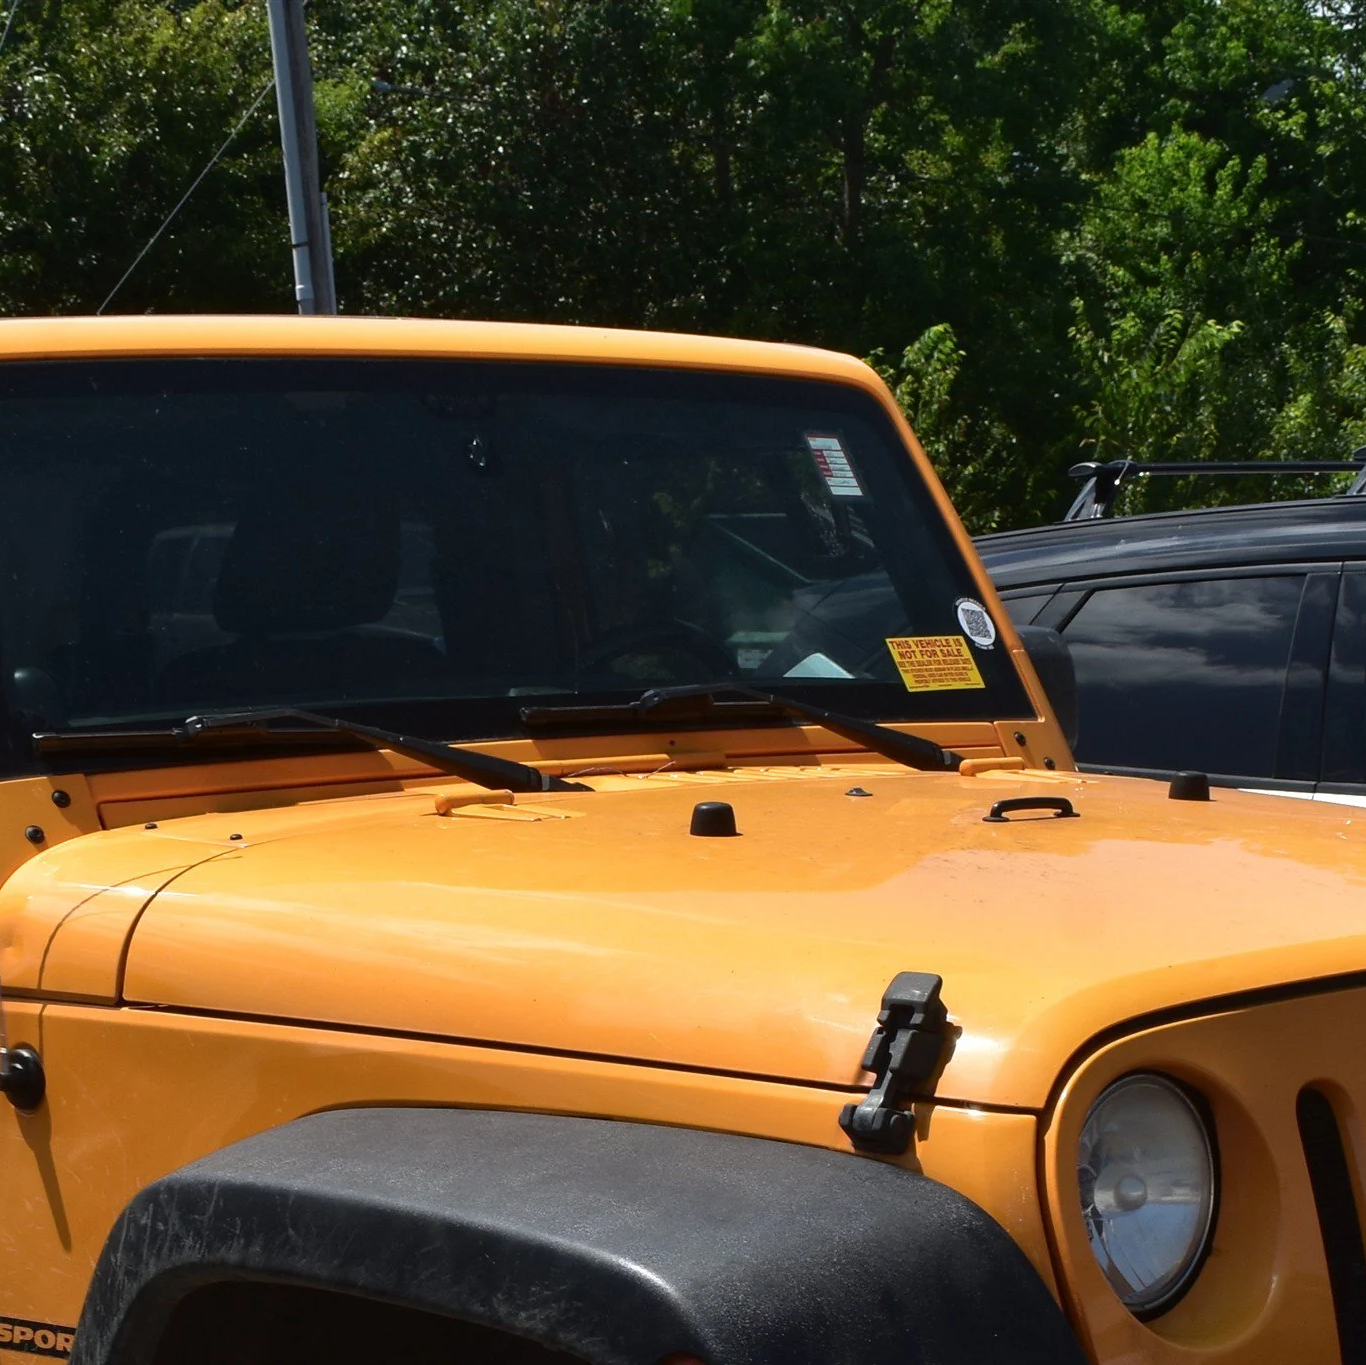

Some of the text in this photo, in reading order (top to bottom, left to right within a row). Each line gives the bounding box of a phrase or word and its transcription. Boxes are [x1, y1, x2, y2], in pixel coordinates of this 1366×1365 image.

[889, 638, 963, 650] THIS VEHICLE IS
[897, 648, 964, 660] NOT FOR SALE
